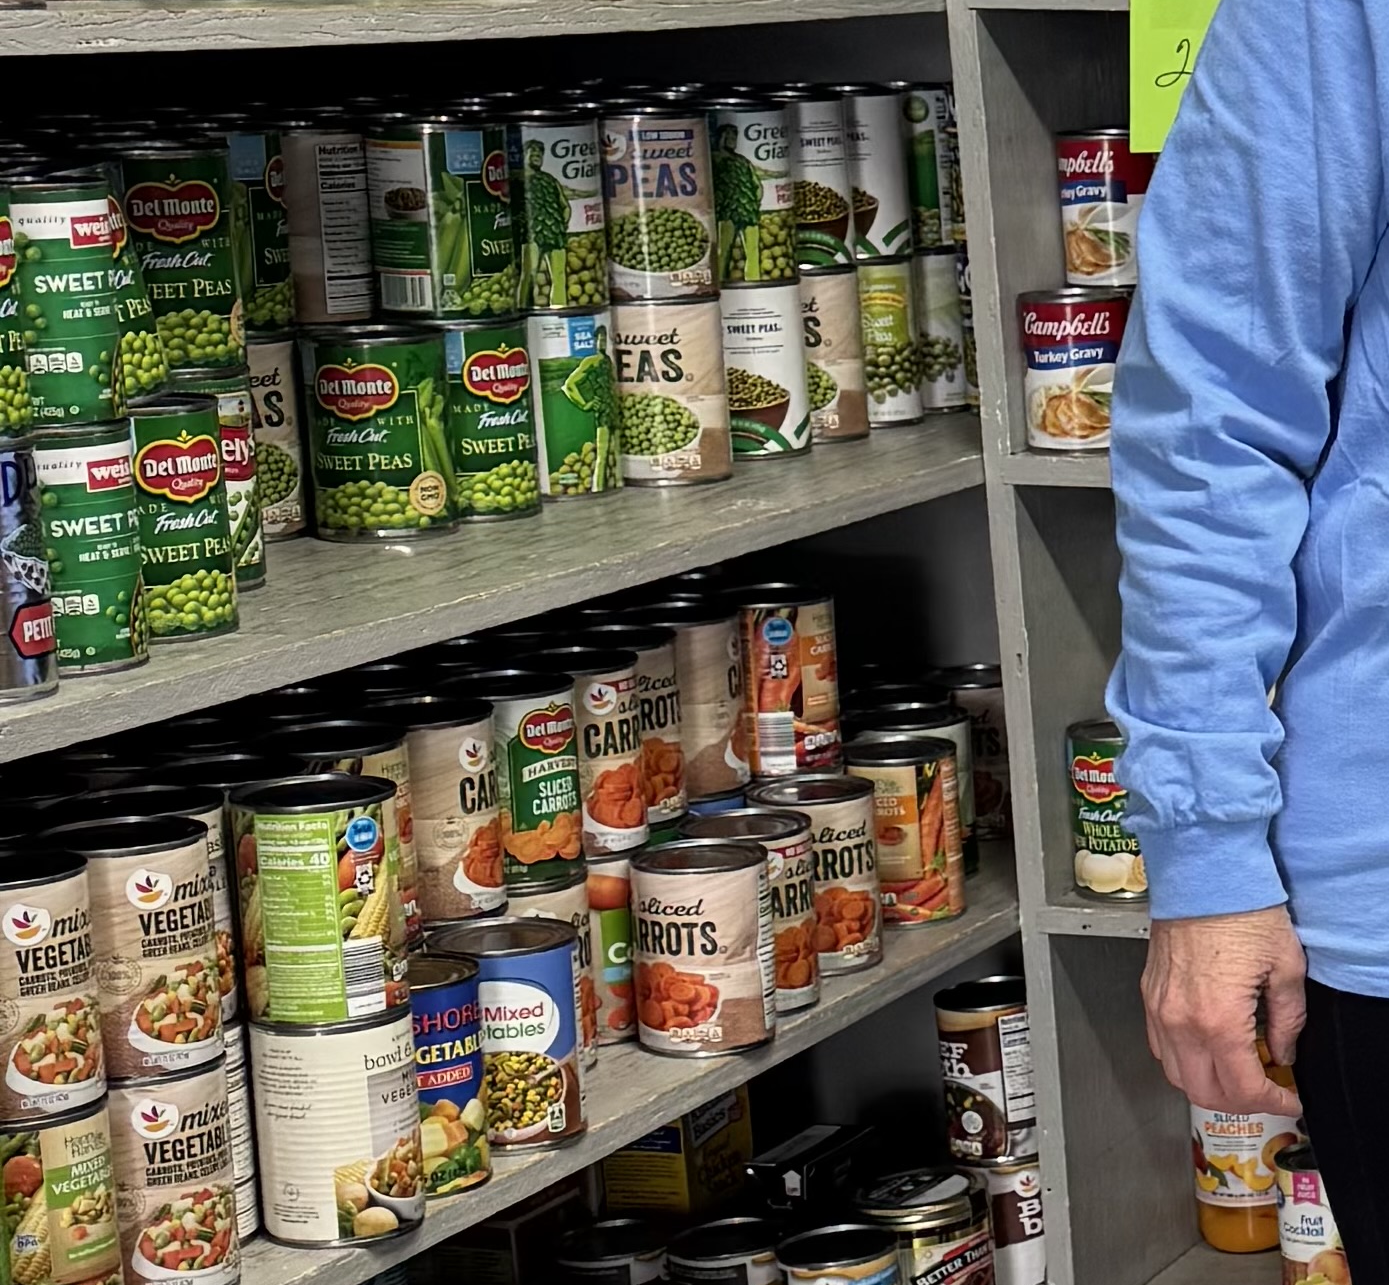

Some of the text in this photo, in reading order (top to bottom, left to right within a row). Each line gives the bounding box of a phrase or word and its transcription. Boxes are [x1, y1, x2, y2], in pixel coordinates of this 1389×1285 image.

[630, 142, 694, 160] sweet
[163, 198, 215, 216] Monte
[34, 271, 104, 294] SWEET
[1023, 311, 1113, 341] Campbell's
[613, 329, 681, 347] sweet
[1033, 345, 1105, 364] Turkey Gravy
[342, 378, 393, 397] Monte
[317, 451, 413, 472] SWEET PEAS
[538, 779, 573, 797] SLICED
[532, 793, 578, 816] CARROTS
[638, 897, 705, 918] sliced
[484, 1002, 545, 1023] Mixed
[427, 1064, 472, 1087] ADDED
[1204, 1121, 1265, 1138] PEACHES
